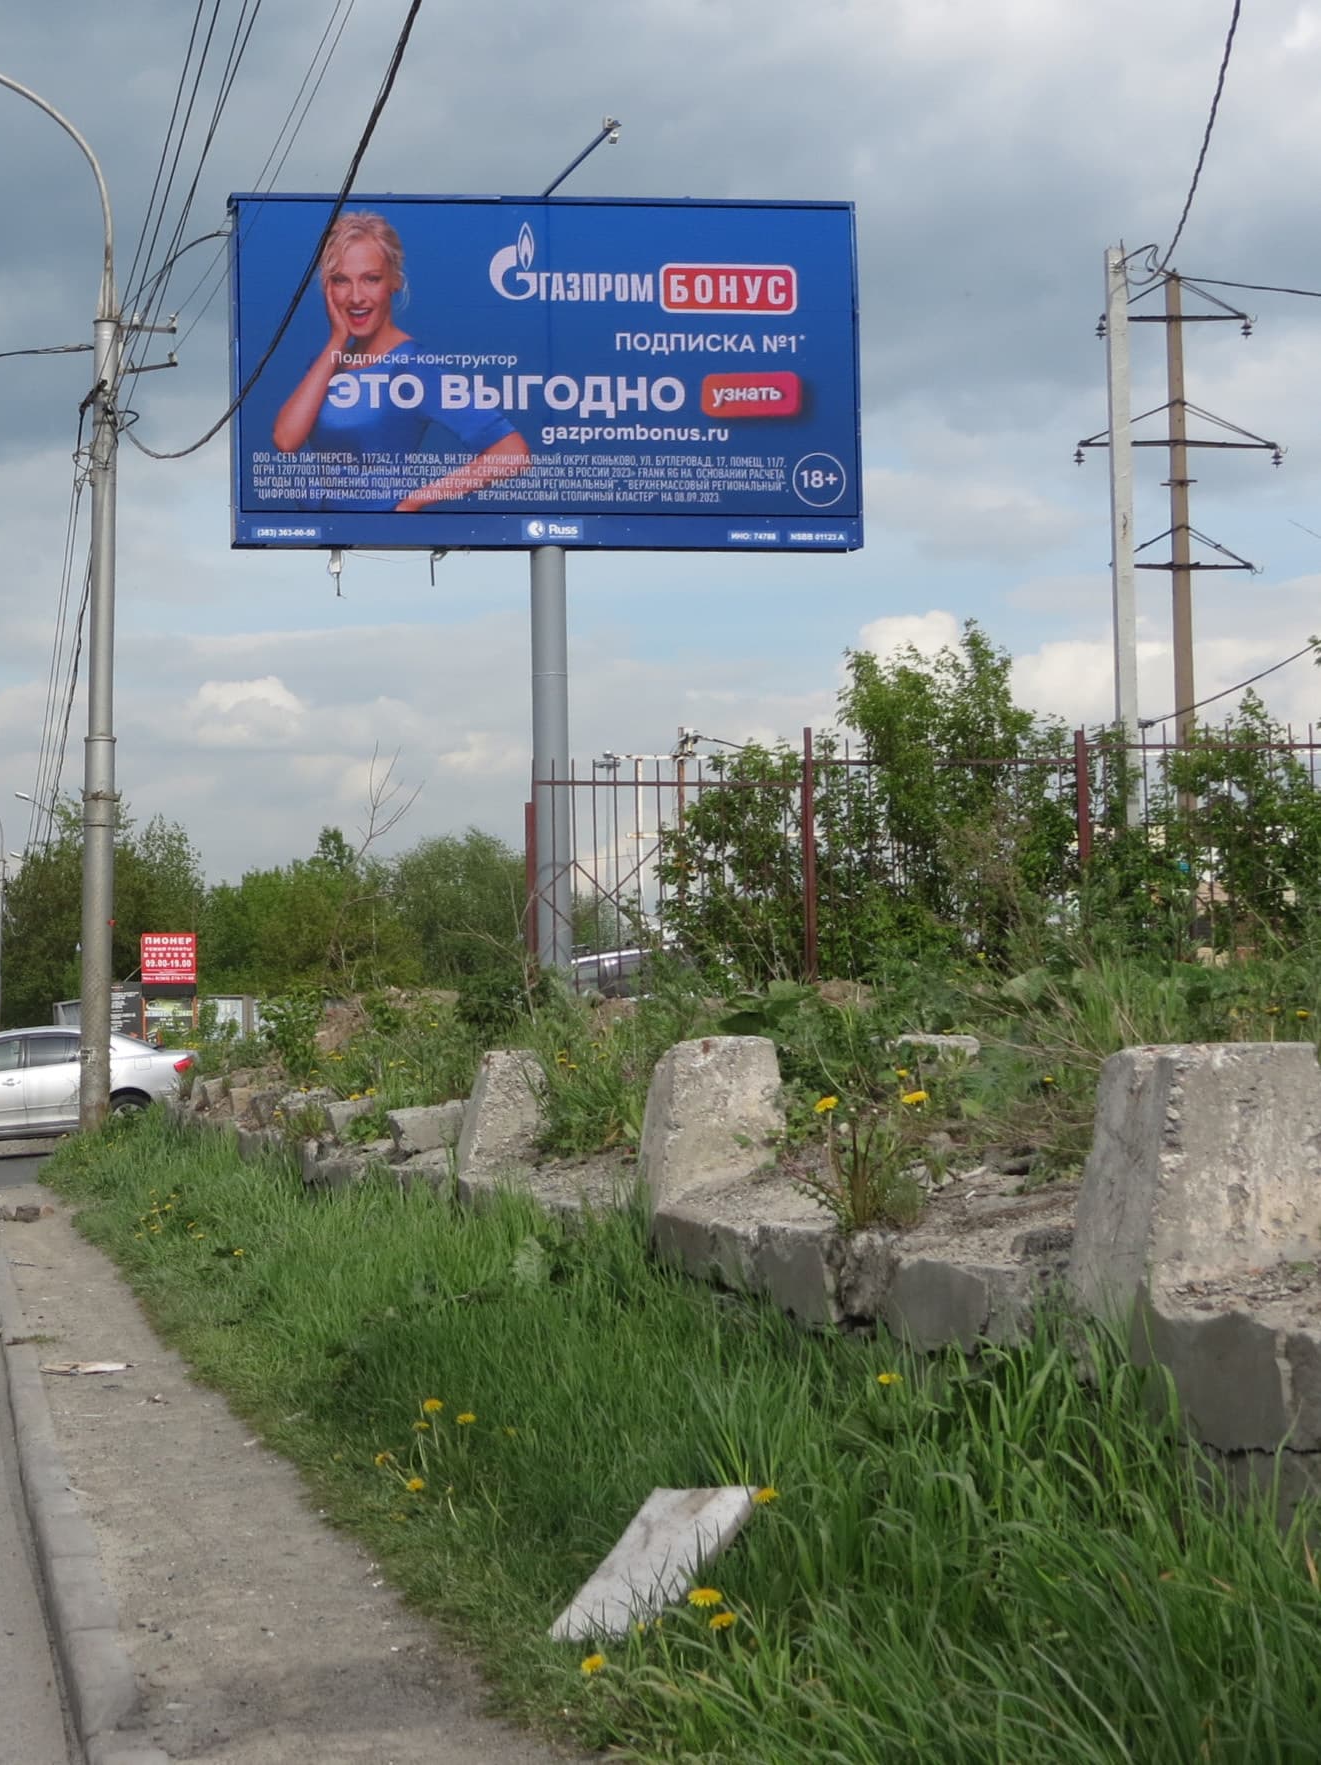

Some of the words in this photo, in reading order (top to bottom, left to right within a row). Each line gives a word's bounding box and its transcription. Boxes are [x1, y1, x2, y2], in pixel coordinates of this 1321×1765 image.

[538, 272, 654, 302] ГАЗПРОМ
[669, 274, 787, 305] БОНУС
[615, 332, 756, 355] ПОДПИСКА
[330, 350, 518, 369] Подписка-конструктор
[327, 372, 425, 410] ЭТО
[440, 373, 686, 419] ВЫГОДНО
[712, 385, 783, 408] узнать
[540, 423, 729, 445] gazprombonus.ru
[252, 452, 270, 463] ООО
[483, 453, 561, 466] МУНИЦИПАЛЬНЫЙ
[563, 454, 590, 466] ОКРУГ
[252, 464, 275, 475] ОГРН
[361, 465, 400, 476] ДАННЫМ
[402, 465, 470, 477] ИССЛЕДОВАНИЯ
[519, 466, 566, 478] ПОДПИСОК
[567, 467, 574, 478] В
[575, 467, 610, 478] РОССИИ
[637, 467, 666, 479] FRANK
[680, 468, 693, 479] НА
[696, 468, 747, 479] ОСНОВАНИИ
[748, 468, 785, 480] РАСЧЕТА
[799, 469, 838, 489] 18+
[253, 476, 292, 488] ВЫГОДЫ
[294, 477, 306, 487] ПО
[308, 477, 369, 488] НАПОЛНЕНИЮ
[371, 477, 419, 489] ПОДПИСОК
[421, 478, 427, 488] В
[429, 478, 484, 489] КАТЕГОРИЯХ
[309, 488, 391, 500] ВЕРХНЕМАССОВЫЙ
[561, 490, 614, 502] СТОЛИЧНЫЙ
[661, 491, 673, 502] НА
[548, 524, 578, 535] Russ
[144, 936, 192, 945] ПИОНЕР
